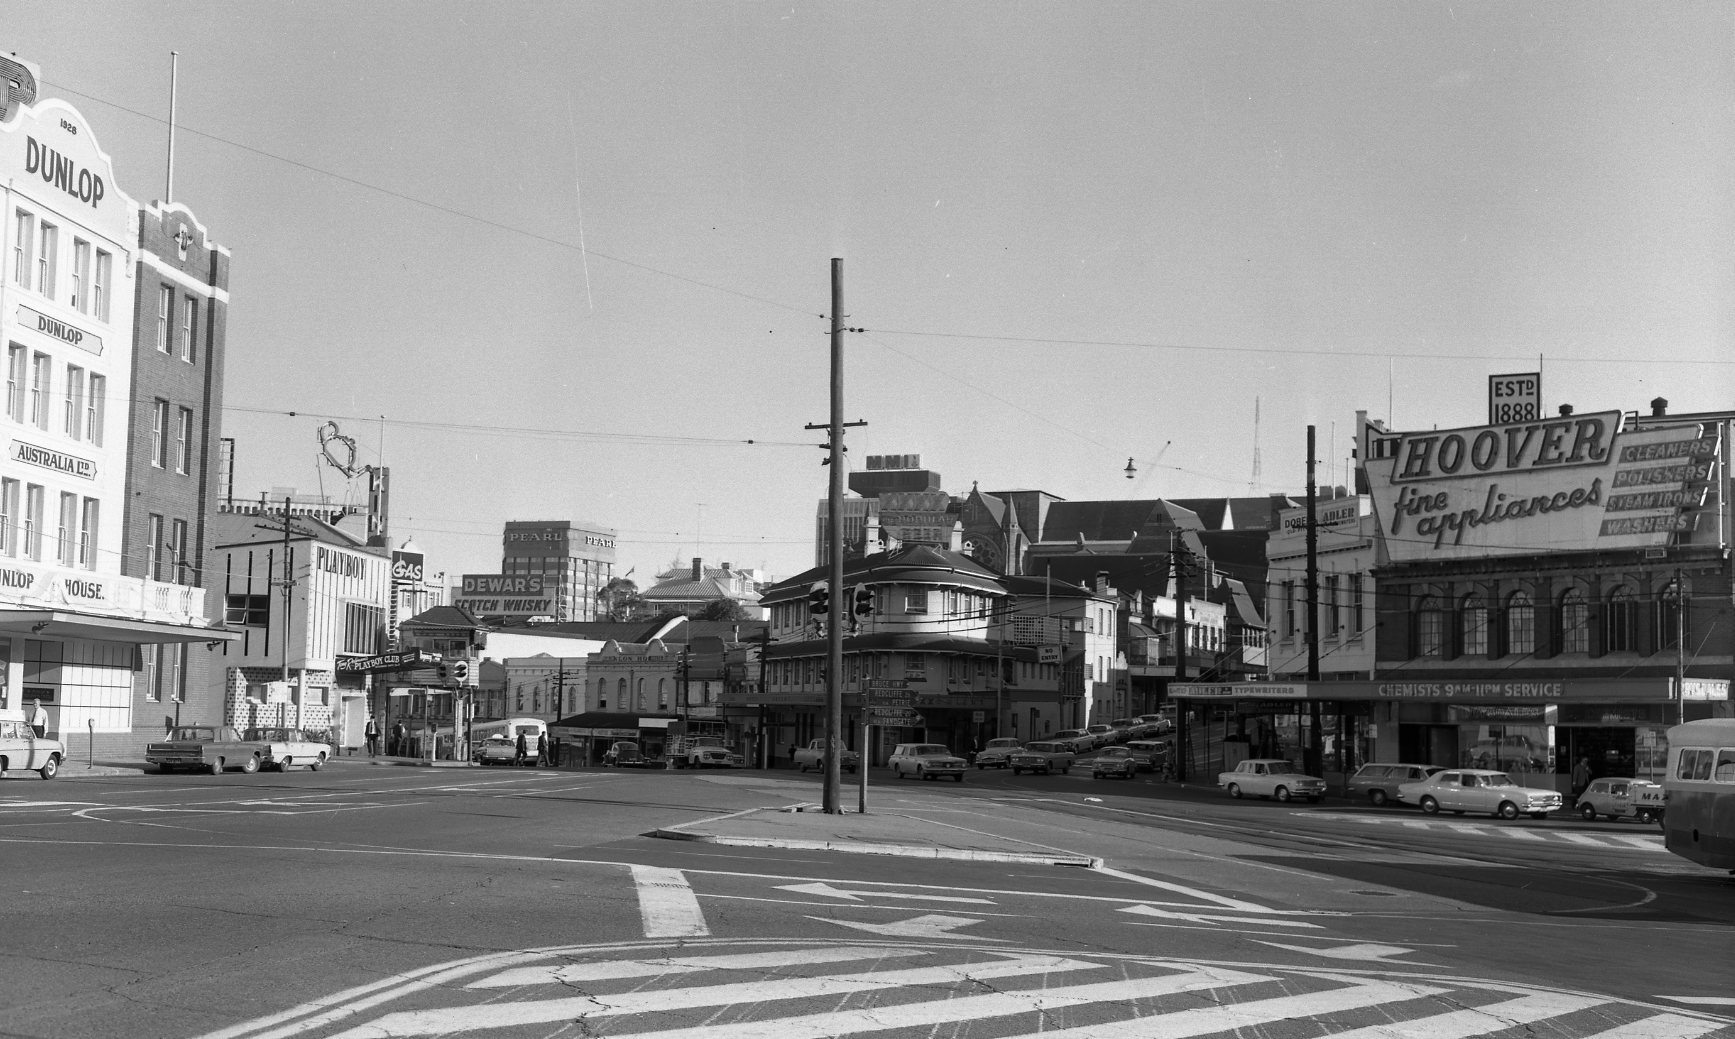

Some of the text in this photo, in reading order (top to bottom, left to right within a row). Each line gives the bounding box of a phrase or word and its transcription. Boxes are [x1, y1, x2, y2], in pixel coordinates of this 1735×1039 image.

[60, 118, 77, 135] 1928
[25, 135, 104, 208] DUNLOP
[38, 315, 83, 345] DUNLOP
[1494, 378, 1535, 397] ESTD
[1495, 402, 1536, 424] 1888
[1400, 418, 1608, 479] HOOVER
[1626, 438, 1713, 461] CLEANERS
[17, 444, 74, 473] AUSTRALIA
[1615, 463, 1708, 487] POLISHERS
[1391, 486, 1449, 536] fine
[1608, 491, 1702, 513] STEAM IRONS
[1323, 508, 1354, 523] ADLER
[1415, 478, 1603, 550] appliances
[1606, 515, 1689, 535] WASHERS
[510, 532, 563, 542] PEARL
[586, 535, 616, 548] PEARL
[317, 545, 367, 581] PLAYBOY
[392, 560, 422, 580] GAS
[0, 568, 34, 589] NLOP
[464, 576, 541, 592] DEWAR'S
[454, 599, 552, 612] SCOTCH WHISKY
[354, 657, 383, 670] PLAYBOY
[384, 655, 400, 663] CLUB
[872, 680, 889, 688] BRUCE
[1235, 686, 1294, 694] TYPEWRITERS
[1378, 683, 1440, 697] CHEMISTS
[1504, 683, 1562, 697] SERVICE
[874, 690, 902, 698] REDCLIFFE
[874, 709, 902, 717] REDCLIFFE
[883, 717, 911, 726] SANDGATE
